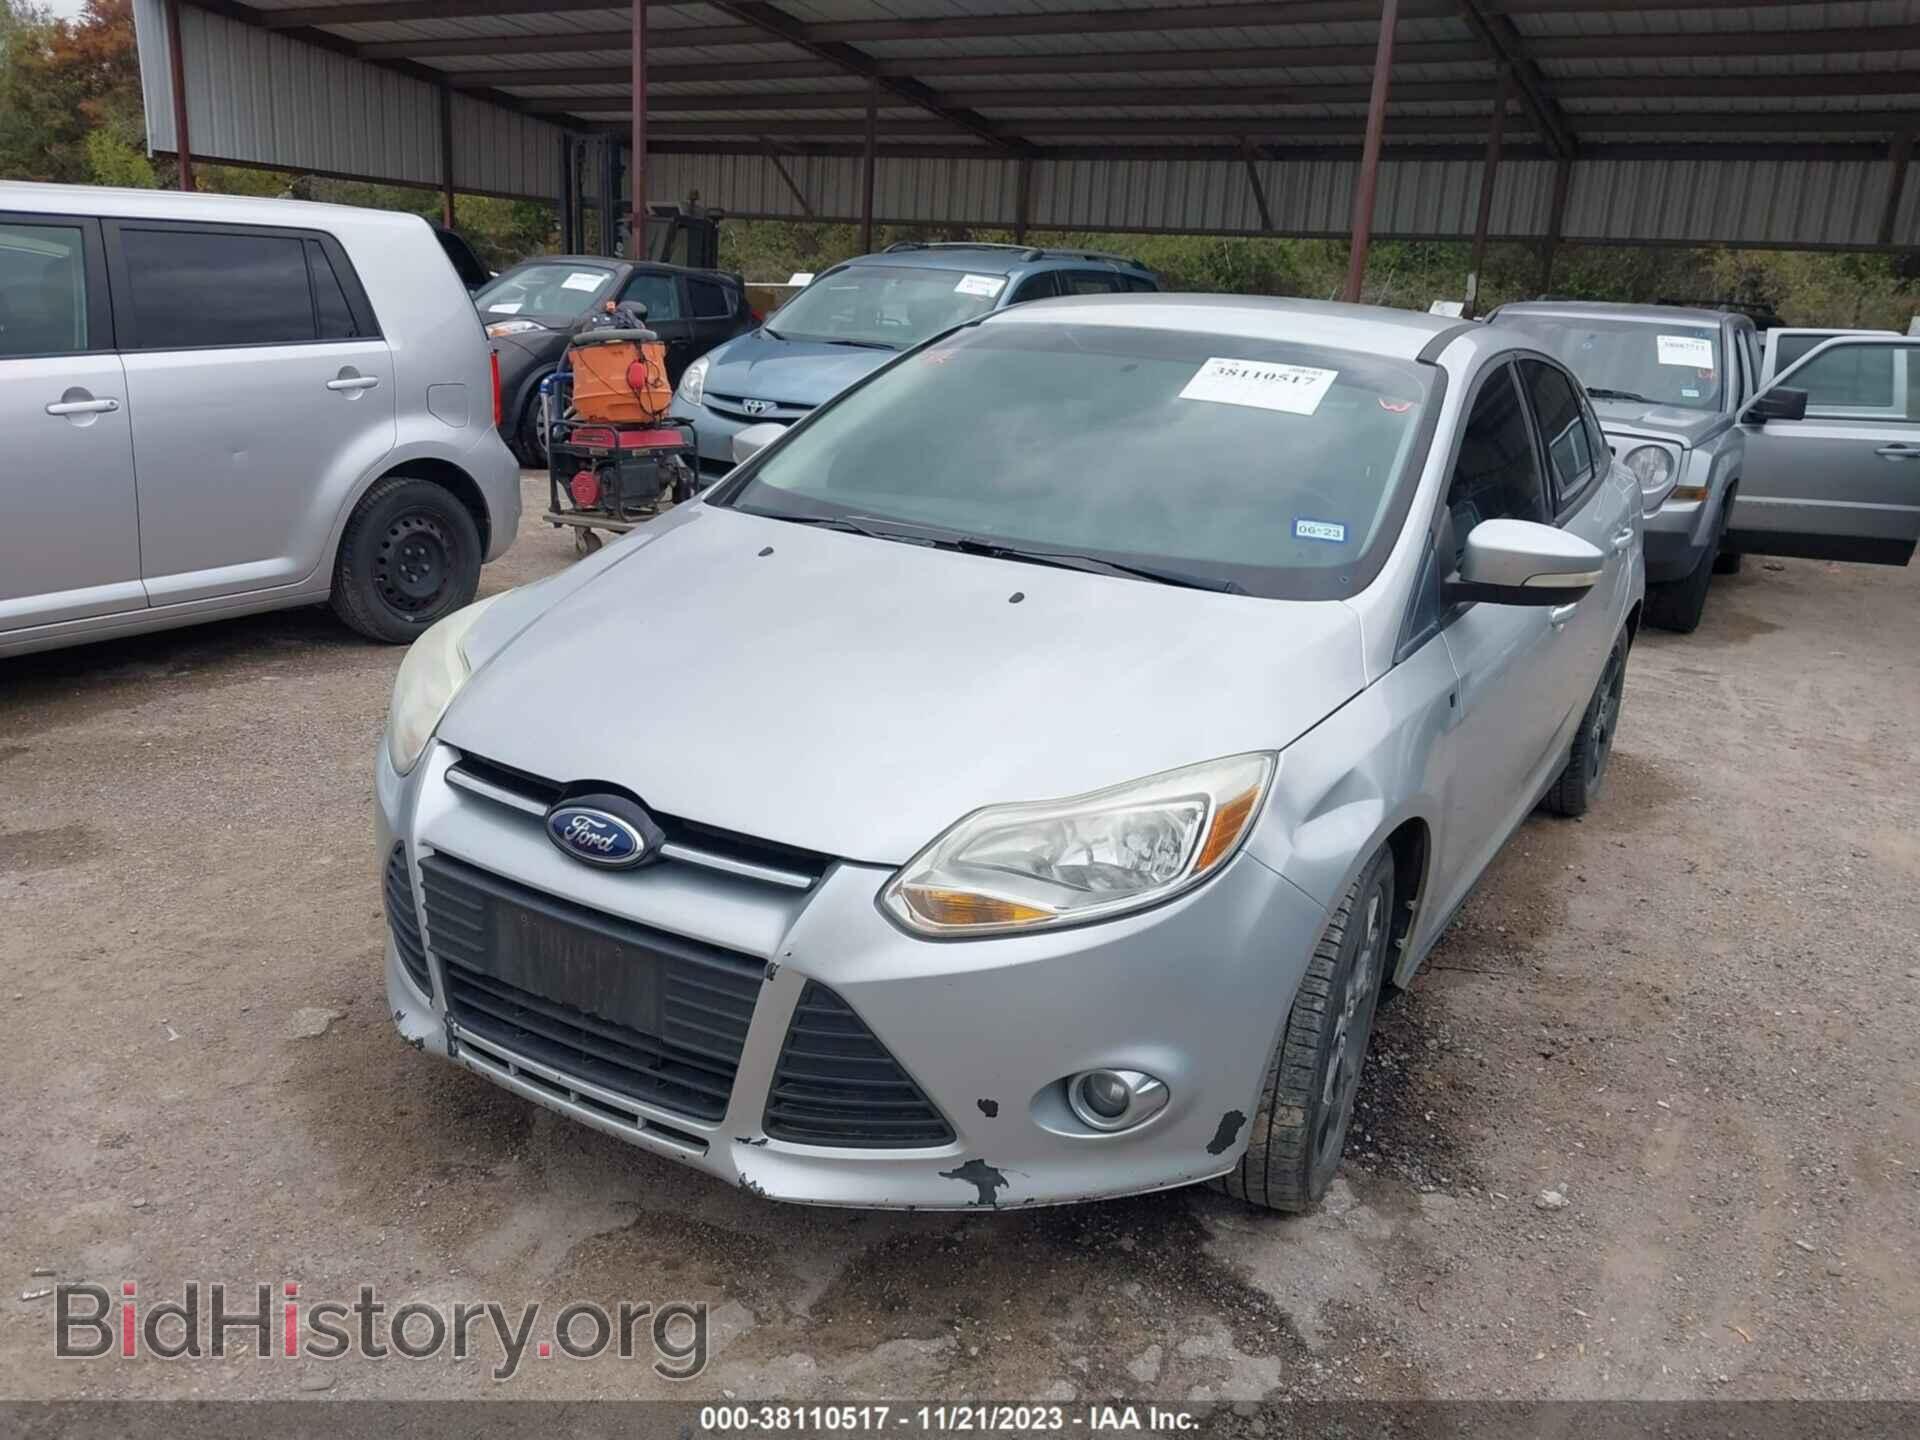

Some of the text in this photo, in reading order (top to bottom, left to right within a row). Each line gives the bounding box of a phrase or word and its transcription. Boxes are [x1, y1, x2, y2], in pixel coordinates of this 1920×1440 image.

[1215, 366, 1317, 385] 38110517
[1298, 525, 1341, 538] 06-23
[564, 815, 618, 852] Ford
